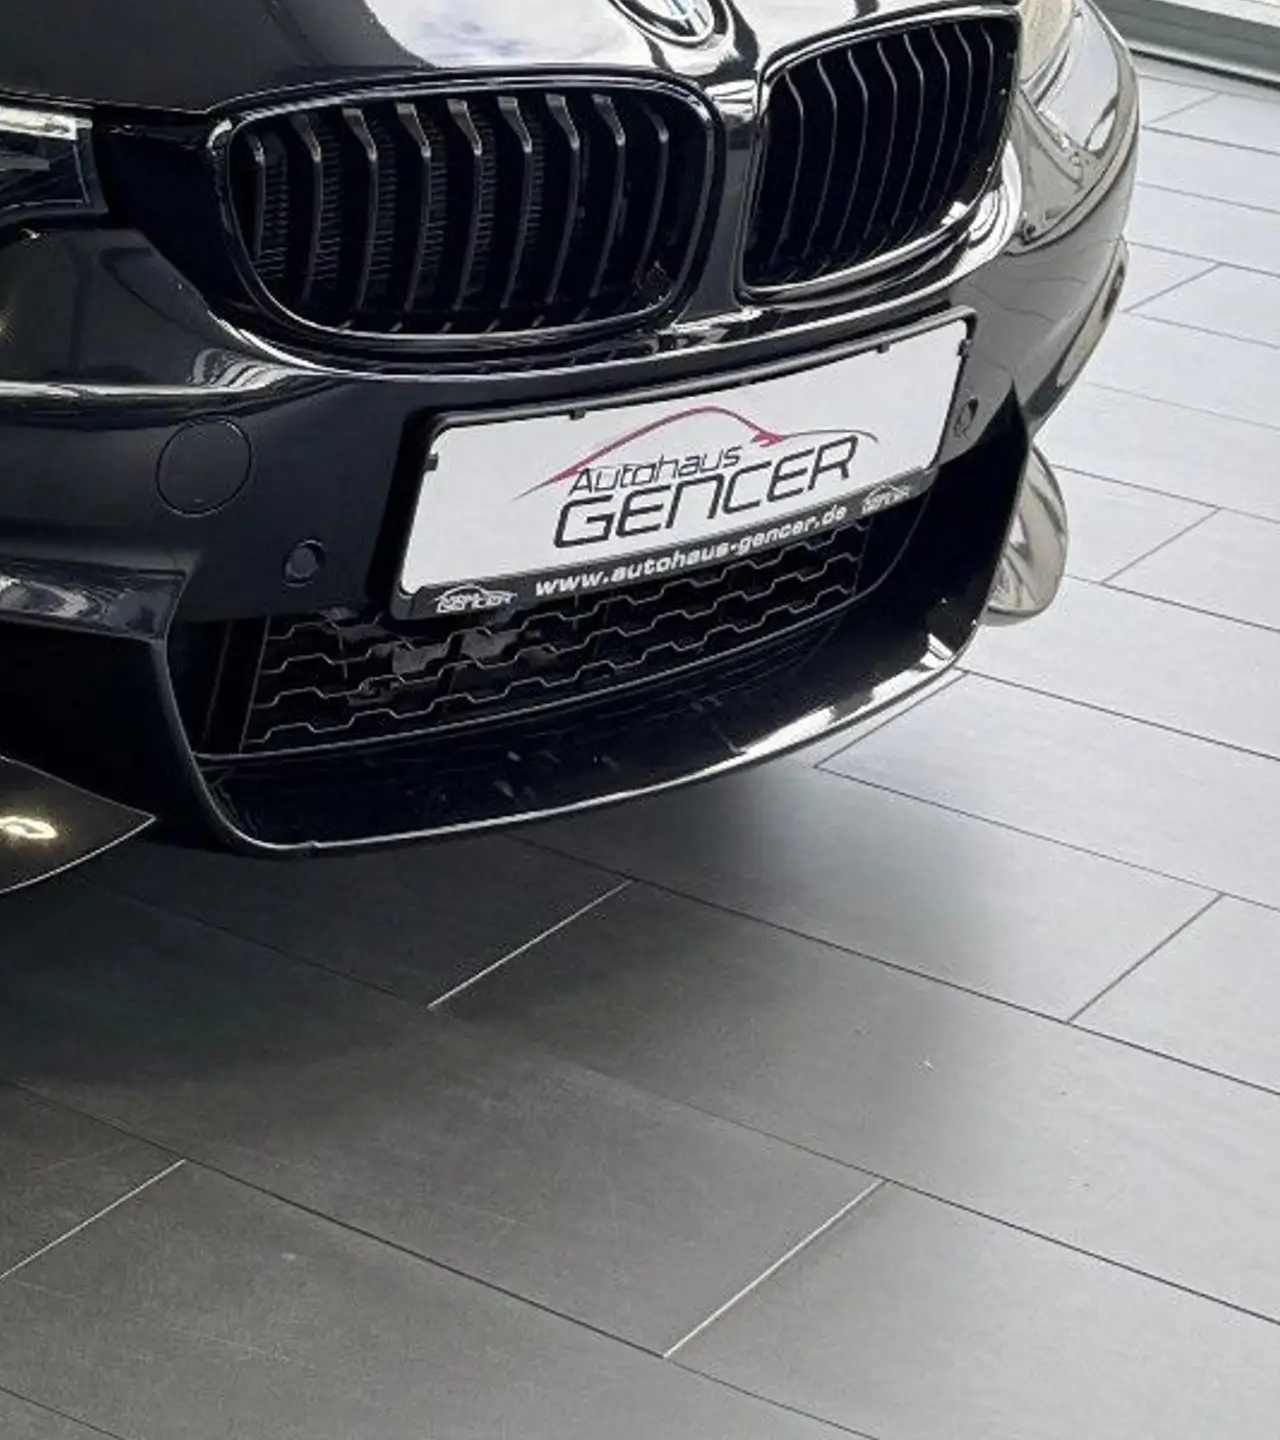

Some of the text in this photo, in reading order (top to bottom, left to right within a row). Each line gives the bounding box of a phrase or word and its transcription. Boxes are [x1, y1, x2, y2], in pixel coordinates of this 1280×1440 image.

[553, 435, 858, 548] GENCER
[568, 445, 742, 496] Autohaus
[535, 503, 847, 597] www.autohaus-gencer.de
